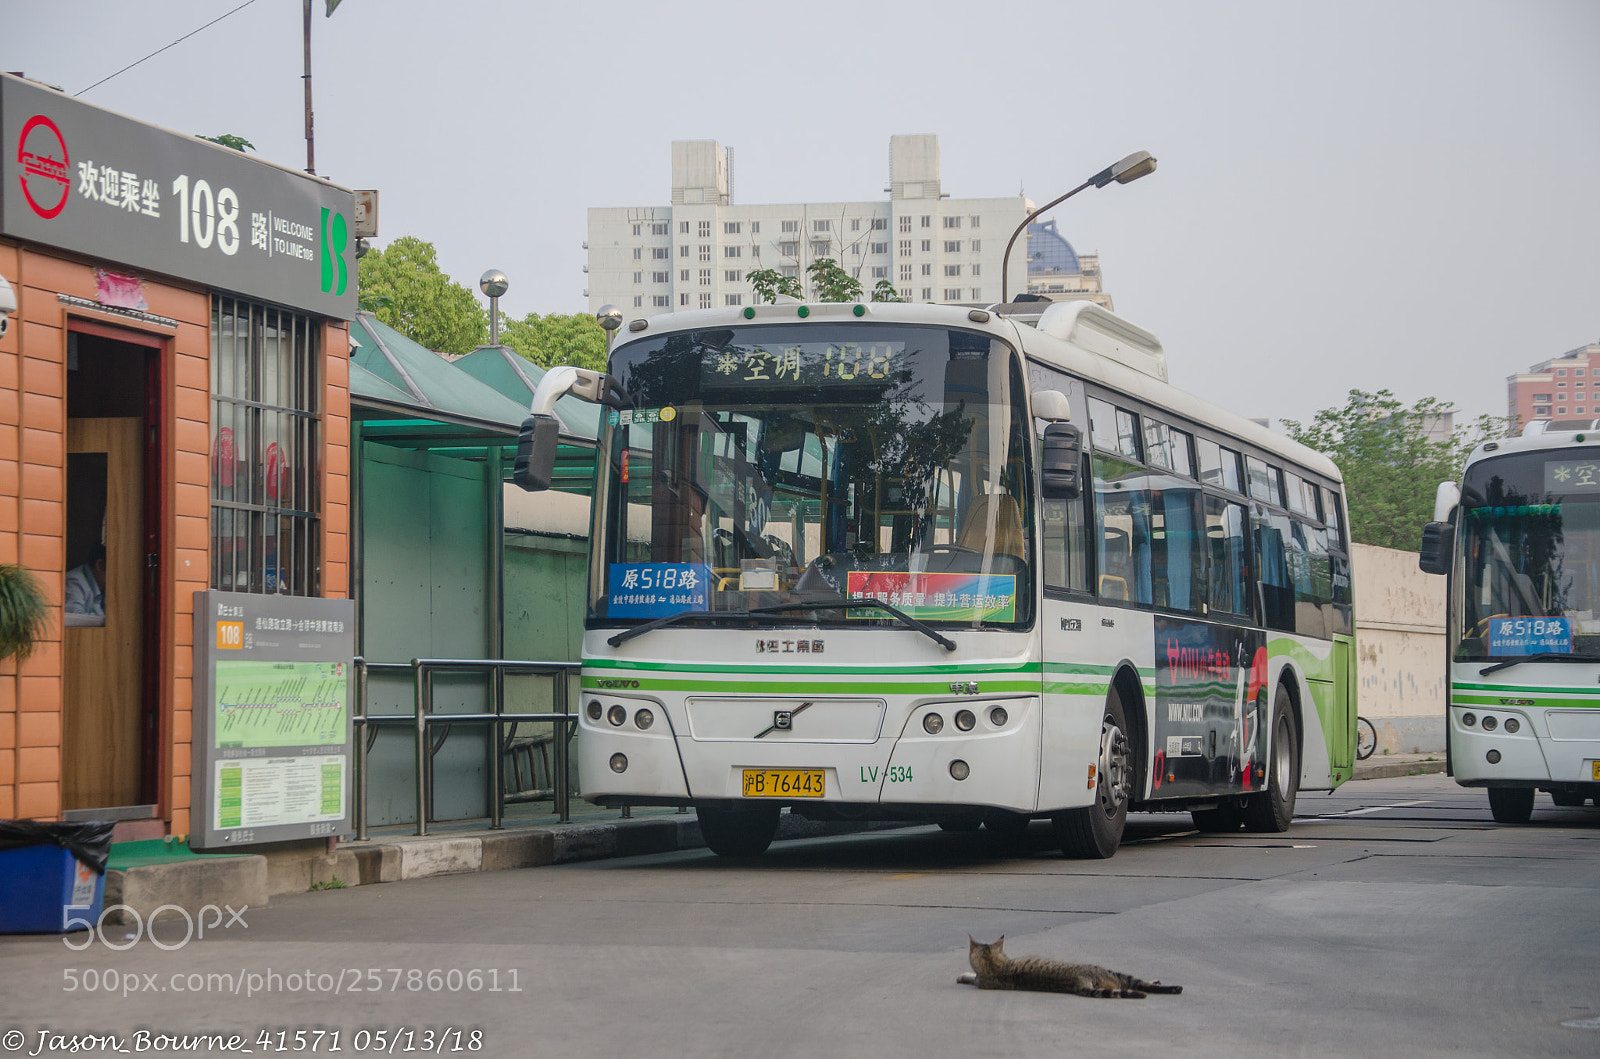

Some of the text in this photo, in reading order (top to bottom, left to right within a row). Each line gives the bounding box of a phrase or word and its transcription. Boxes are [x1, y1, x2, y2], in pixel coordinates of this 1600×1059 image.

[78, 159, 161, 218] 欢迎乘坐
[172, 174, 241, 257] 108
[251, 212, 268, 251] 路
[273, 216, 313, 241] WELCOME
[743, 346, 800, 381] 空调
[1575, 462, 1600, 486] 空
[621, 568, 700, 590] 原518路
[934, 593, 1010, 609] 提升营运效率
[221, 625, 240, 645] 108
[1499, 620, 1565, 637] 原518路
[596, 679, 640, 688] VOLVO
[1499, 698, 1535, 706] VOLVO
